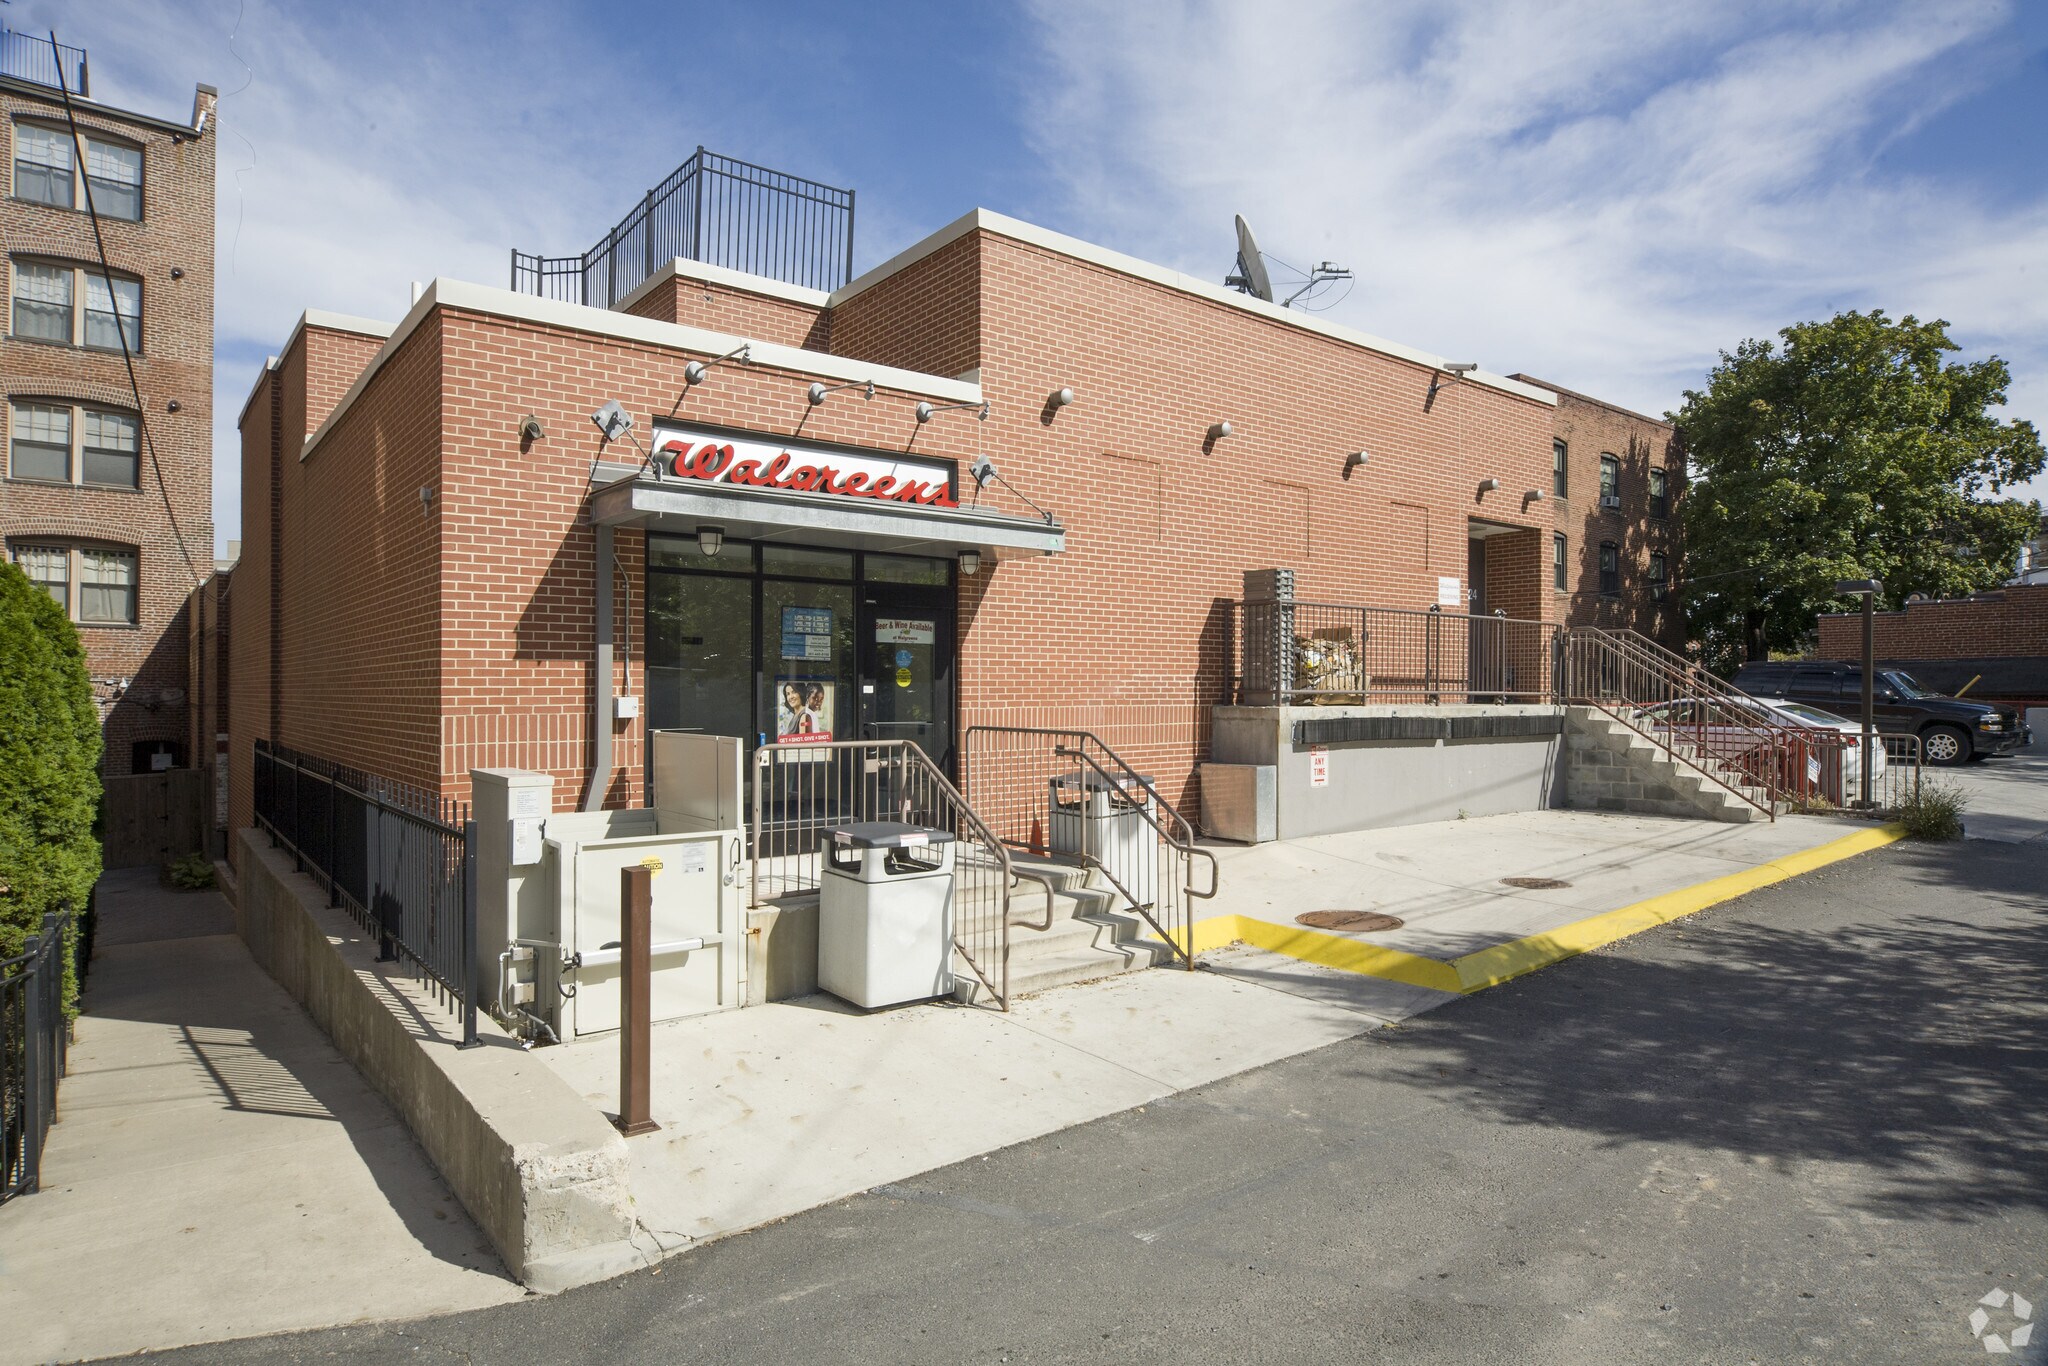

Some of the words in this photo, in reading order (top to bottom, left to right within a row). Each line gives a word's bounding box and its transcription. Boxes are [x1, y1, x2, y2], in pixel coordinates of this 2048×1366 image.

[665, 439, 960, 508] Walgreens
[1468, 589, 1477, 600] 24
[875, 622, 888, 630] Beer
[889, 622, 893, 630] &
[895, 621, 908, 629] Wine
[909, 622, 933, 632] Available
[1314, 768, 1326, 776] TIME
